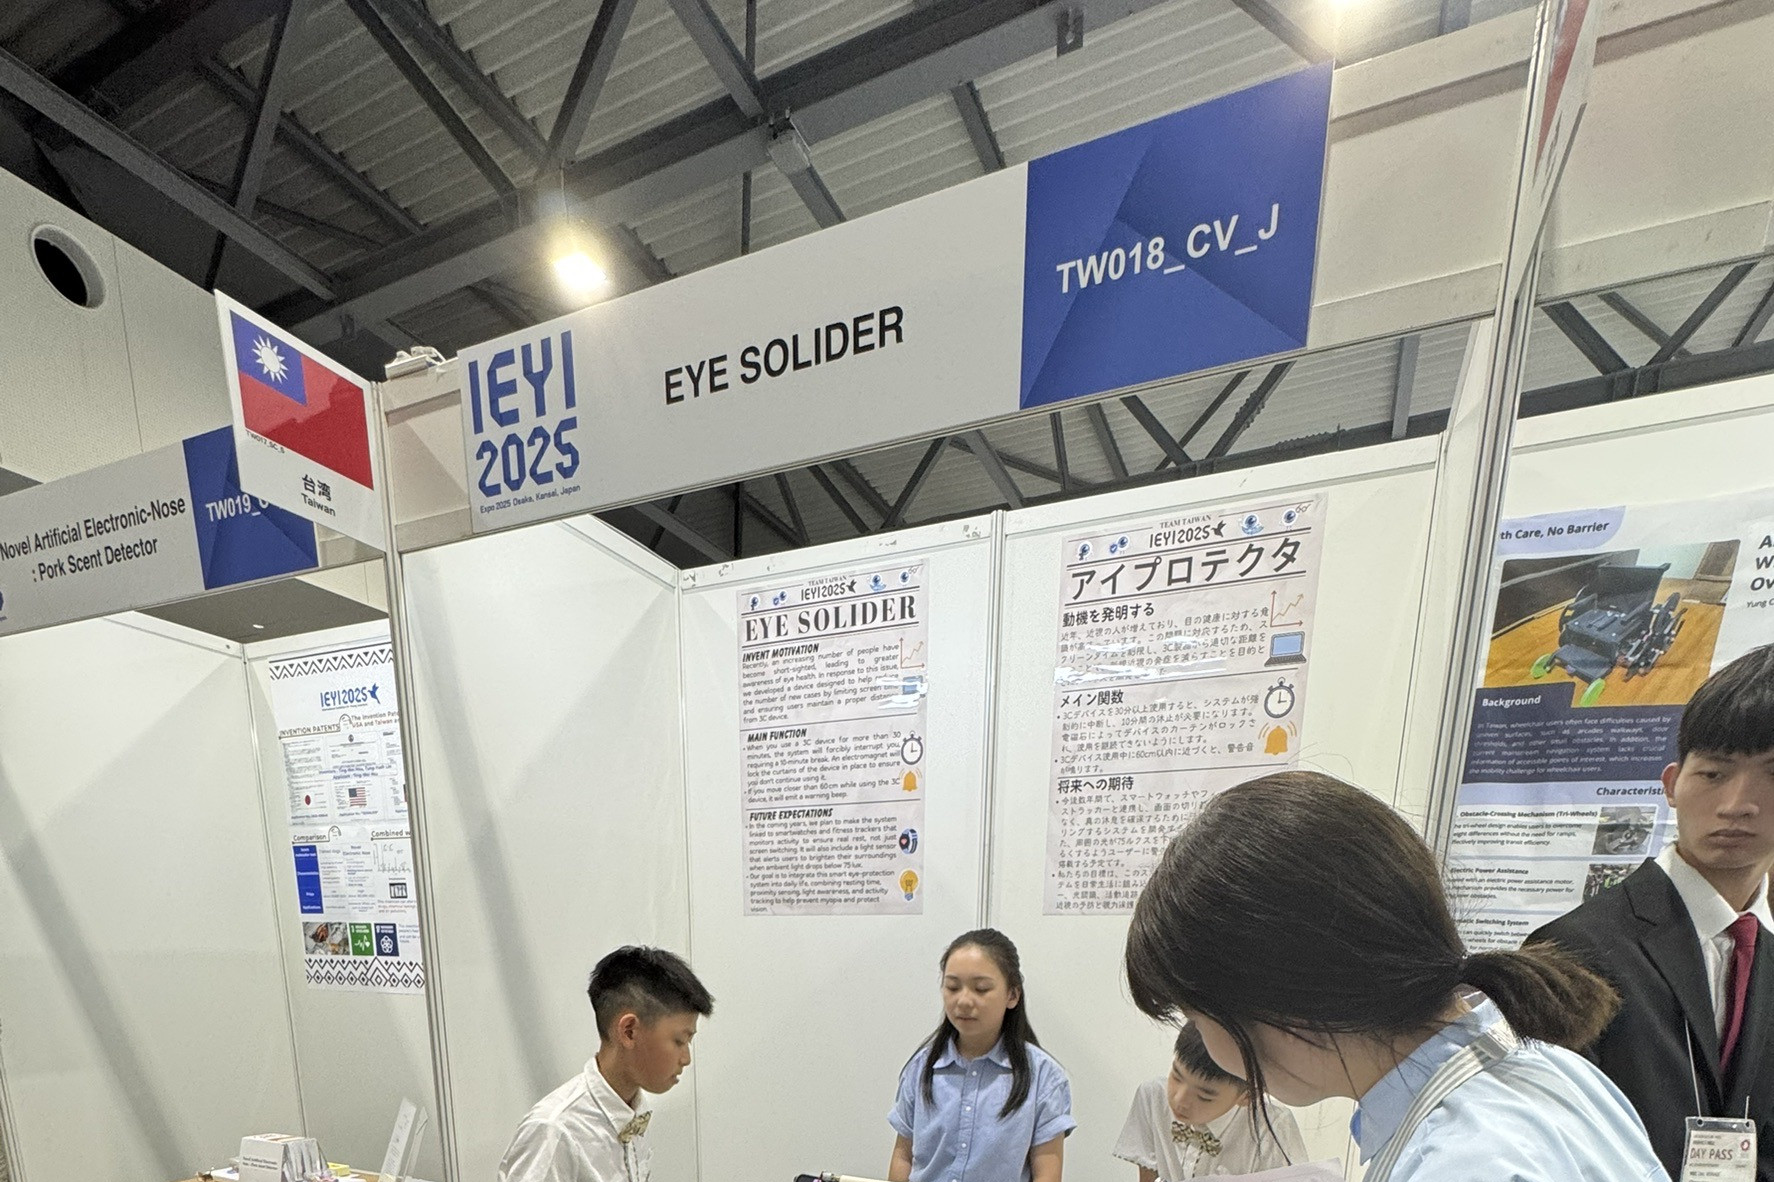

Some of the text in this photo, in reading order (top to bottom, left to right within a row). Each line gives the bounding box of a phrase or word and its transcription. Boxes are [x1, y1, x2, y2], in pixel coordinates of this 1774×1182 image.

[1056, 203, 1280, 294] TW018_CV_J
[665, 305, 904, 405] EYE SOLIDER
[469, 330, 576, 434] IEYI
[476, 416, 579, 497] 2025
[302, 474, 332, 502] 台湾
[301, 493, 336, 517] Taiwan
[480, 484, 580, 514] Expo 2025 Osaka, Kansai, Japan
[0, 498, 186, 562] Novel Artificial Electronic-Nose
[1159, 513, 1211, 529] TEAM TAIWAN
[1499, 520, 1609, 541] th Care, No Barrier
[1149, 523, 1212, 548] IEYI2025
[38, 559, 67, 581] Pork
[68, 551, 103, 574] Scent
[104, 538, 158, 565] Detector
[1070, 535, 1302, 601] アイプロテクタ
[801, 581, 846, 601] IEYI2025
[745, 592, 915, 641] EYE SOLIDER
[1062, 600, 1154, 628] 動機を発明する
[742, 642, 819, 662] INVENT MOTIVATION
[319, 685, 368, 707] IEYI2025
[1060, 688, 1124, 709] メイン関数
[1482, 695, 1541, 709] Background
[279, 722, 340, 737] INVENTION PATENTS
[747, 727, 807, 742] MAIN FUNCTION
[1057, 775, 1134, 794] 将来への期待
[1595, 786, 1665, 797] Characteristi
[749, 807, 833, 821] FUTURE EXPECTATIONS
[292, 833, 327, 842] Comparison
[370, 829, 403, 837] Combined
[1690, 1147, 1733, 1161] DAY PASS
